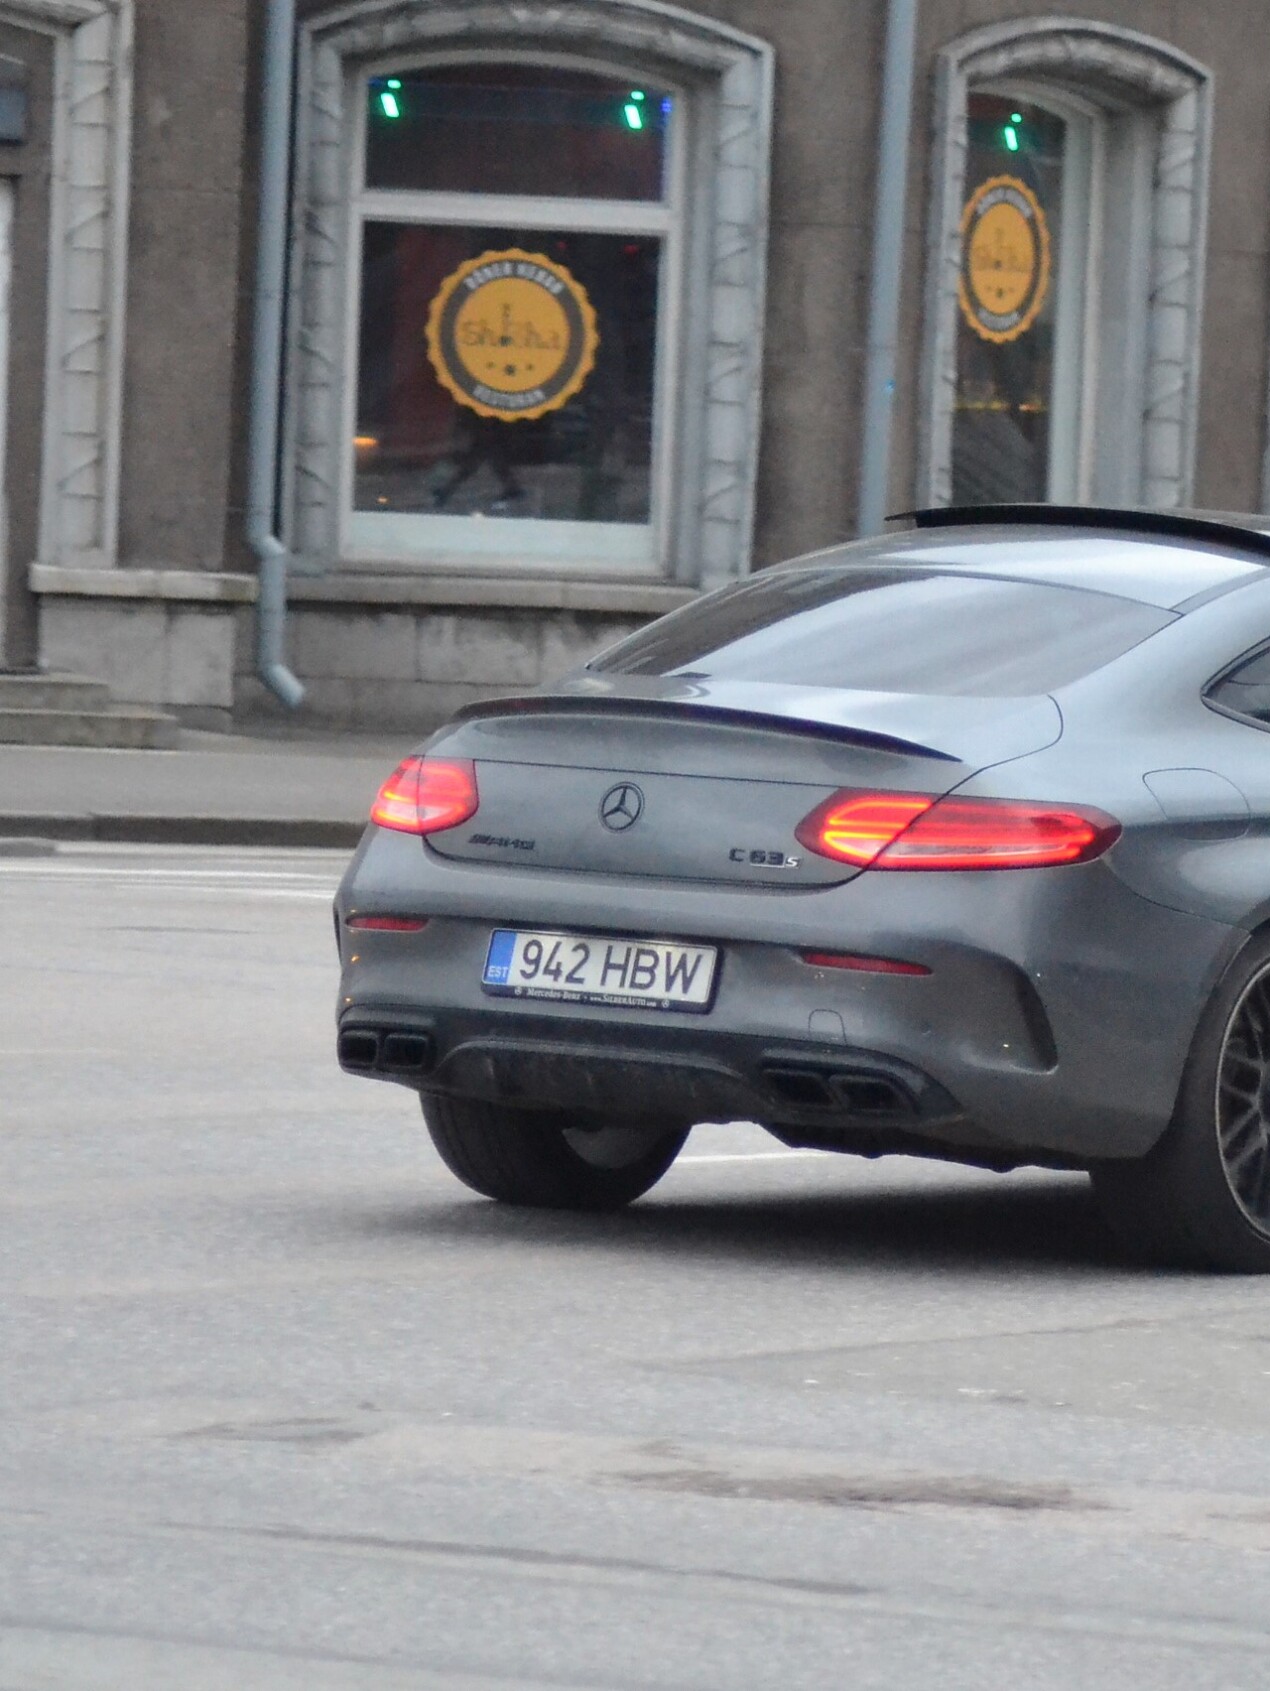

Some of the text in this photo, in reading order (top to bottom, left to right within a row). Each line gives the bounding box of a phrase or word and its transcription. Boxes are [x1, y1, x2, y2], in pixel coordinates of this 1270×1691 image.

[487, 965, 509, 979] EST
[519, 939, 703, 995] 942 HBW
